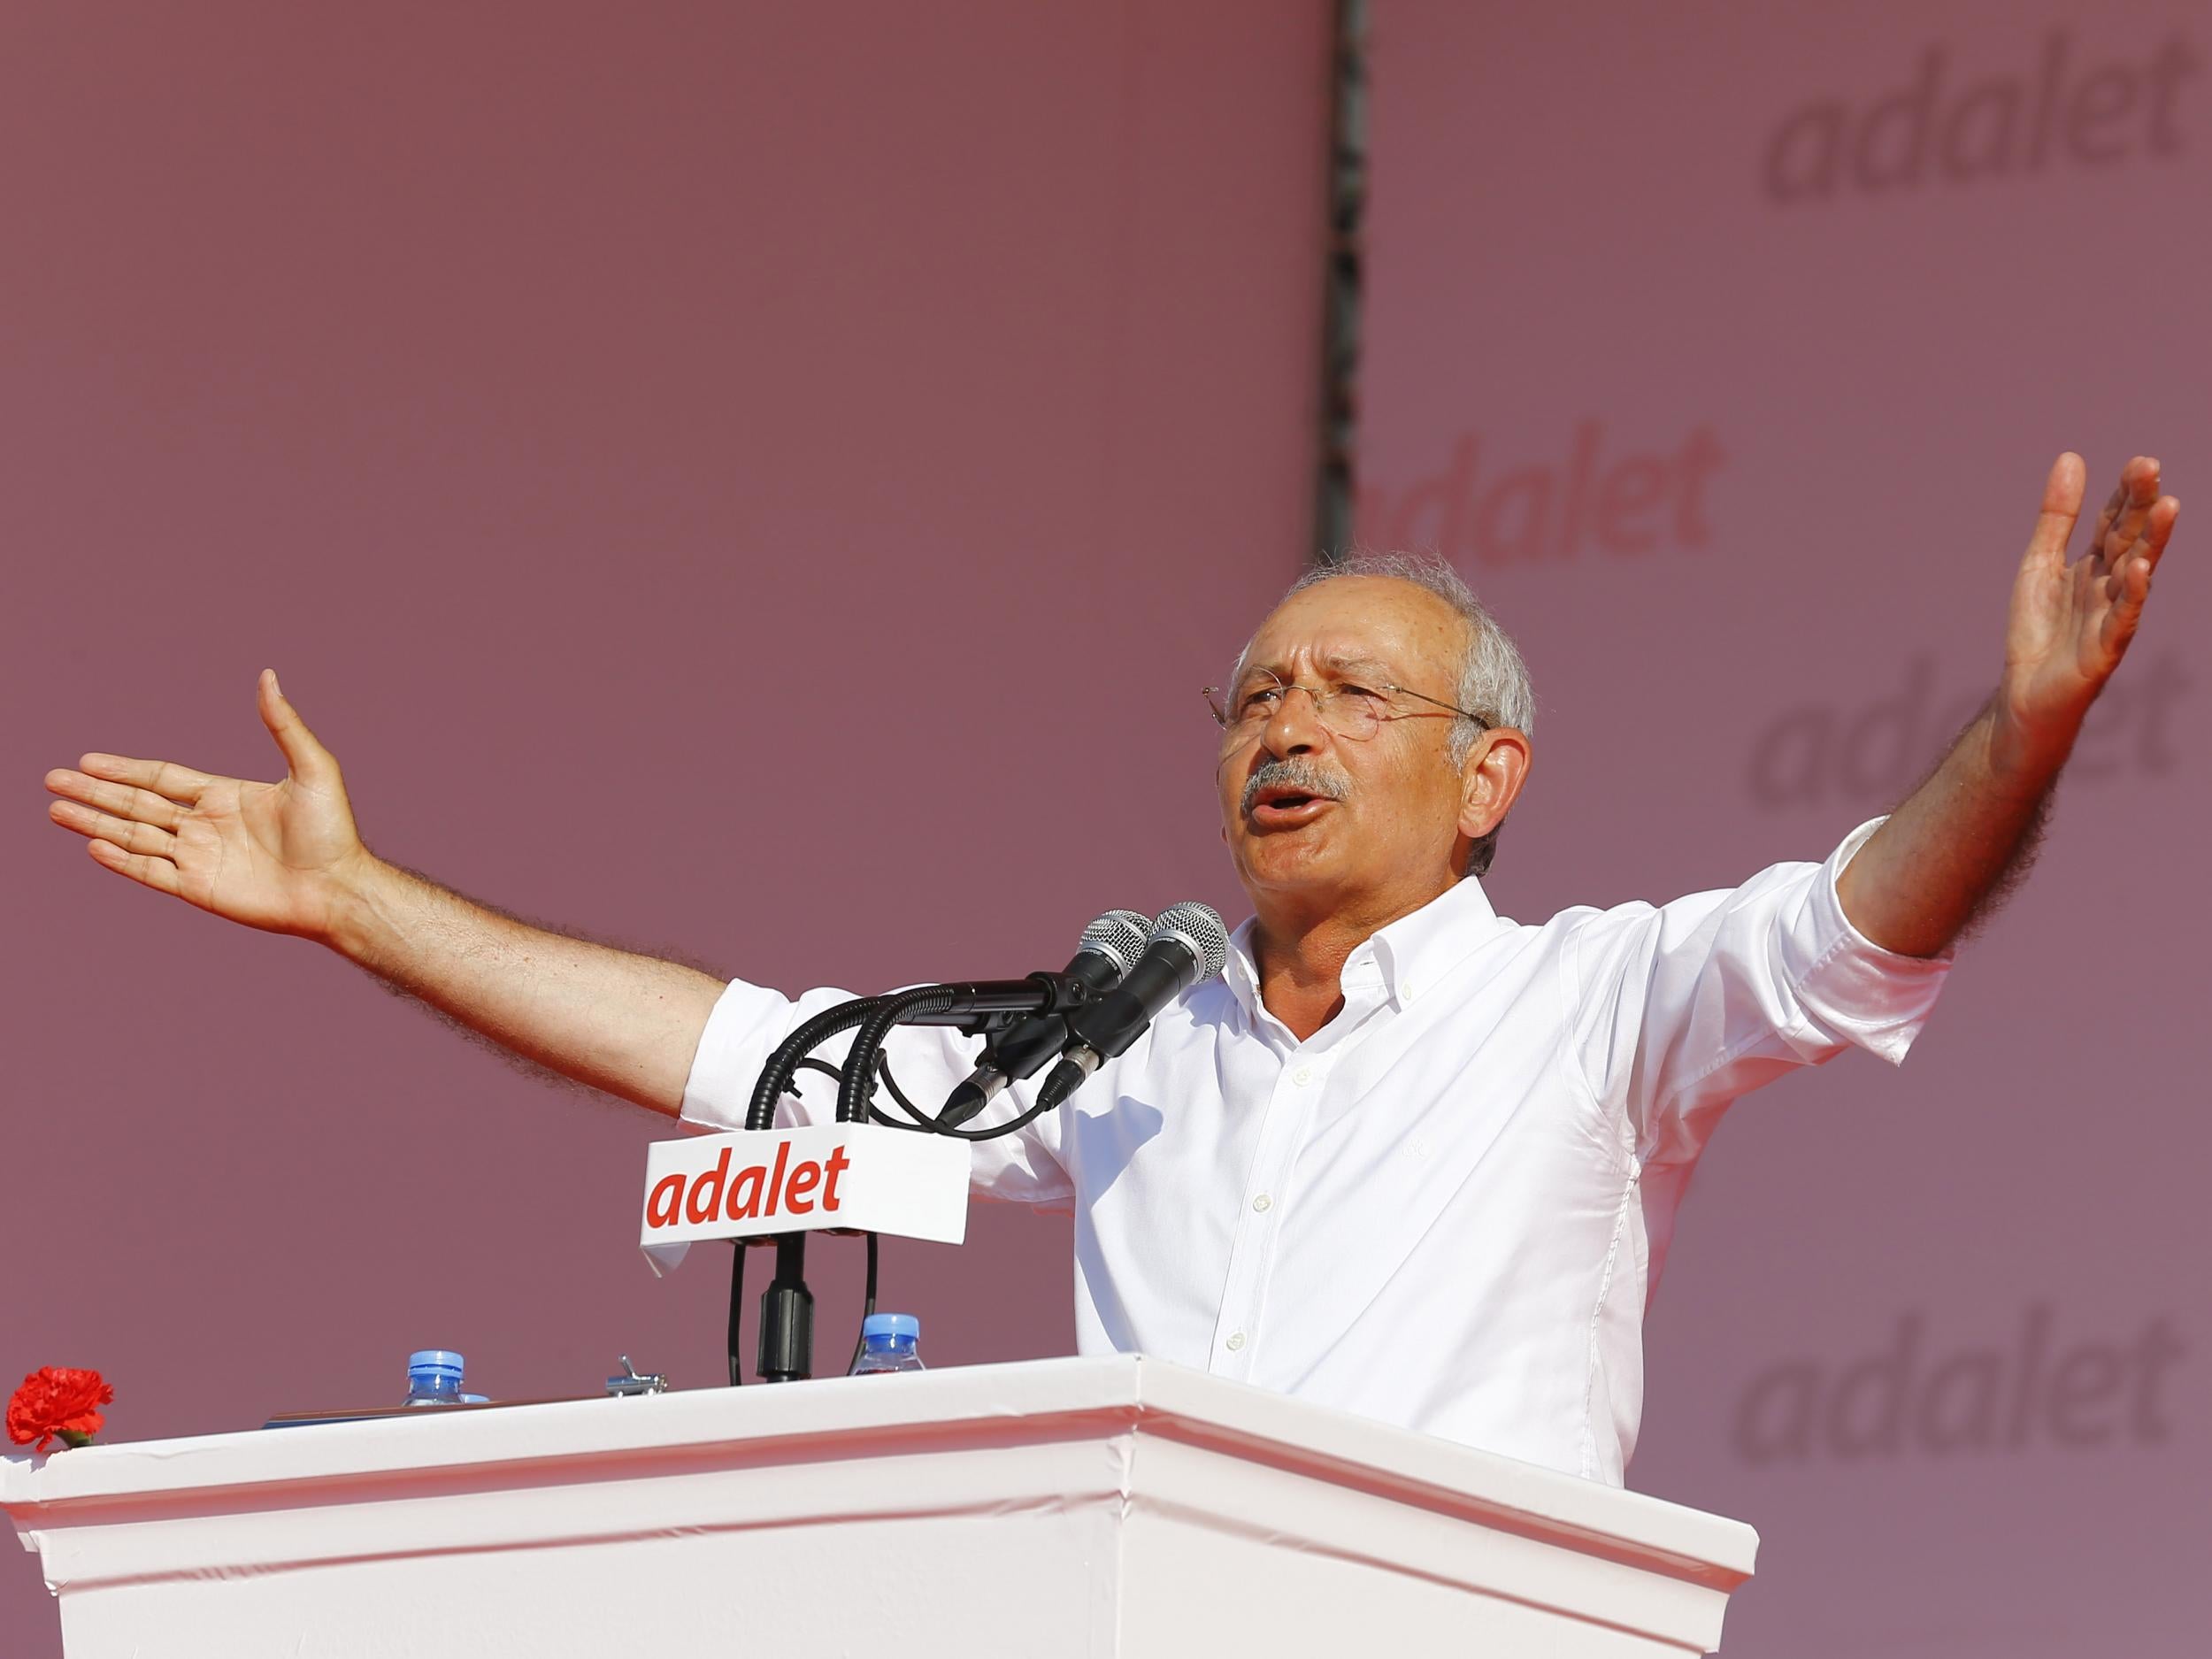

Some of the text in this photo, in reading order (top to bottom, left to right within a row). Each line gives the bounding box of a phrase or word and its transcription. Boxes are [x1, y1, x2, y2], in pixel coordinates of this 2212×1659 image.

[1763, 29, 2200, 204] adalet
[647, 1141, 849, 1228] adalet
[1731, 1301, 2187, 1465] adalet
